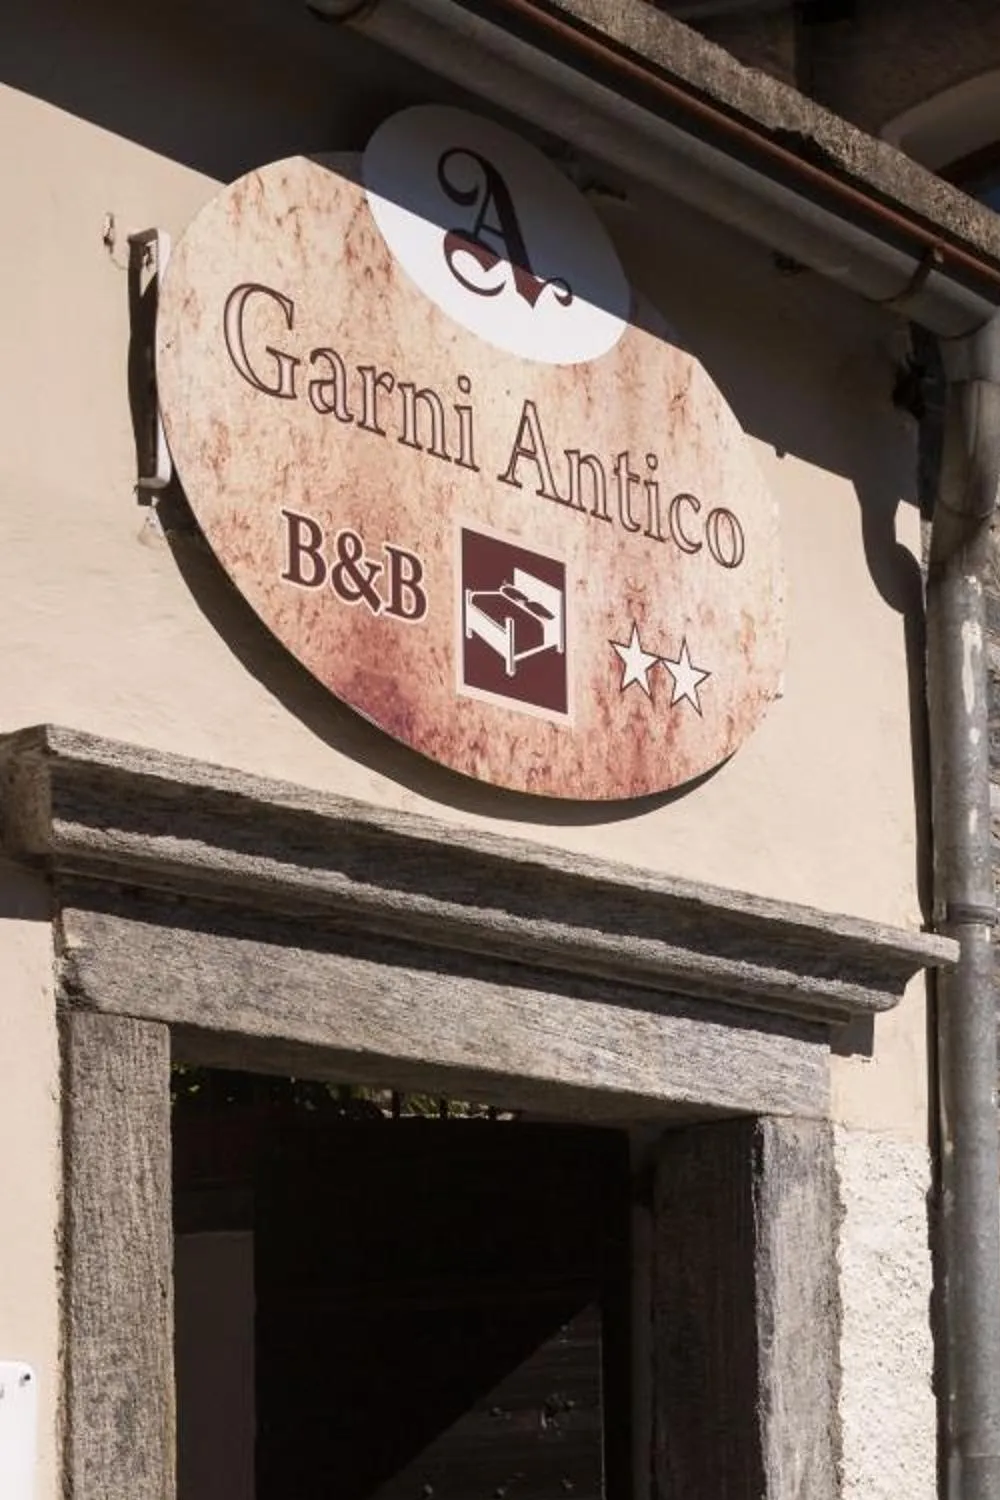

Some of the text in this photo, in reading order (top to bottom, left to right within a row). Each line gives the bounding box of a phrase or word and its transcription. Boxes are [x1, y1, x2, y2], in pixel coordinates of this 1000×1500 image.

[437, 147, 574, 309] A
[223, 282, 746, 569] Garni Antico
[281, 508, 428, 622] B&B
